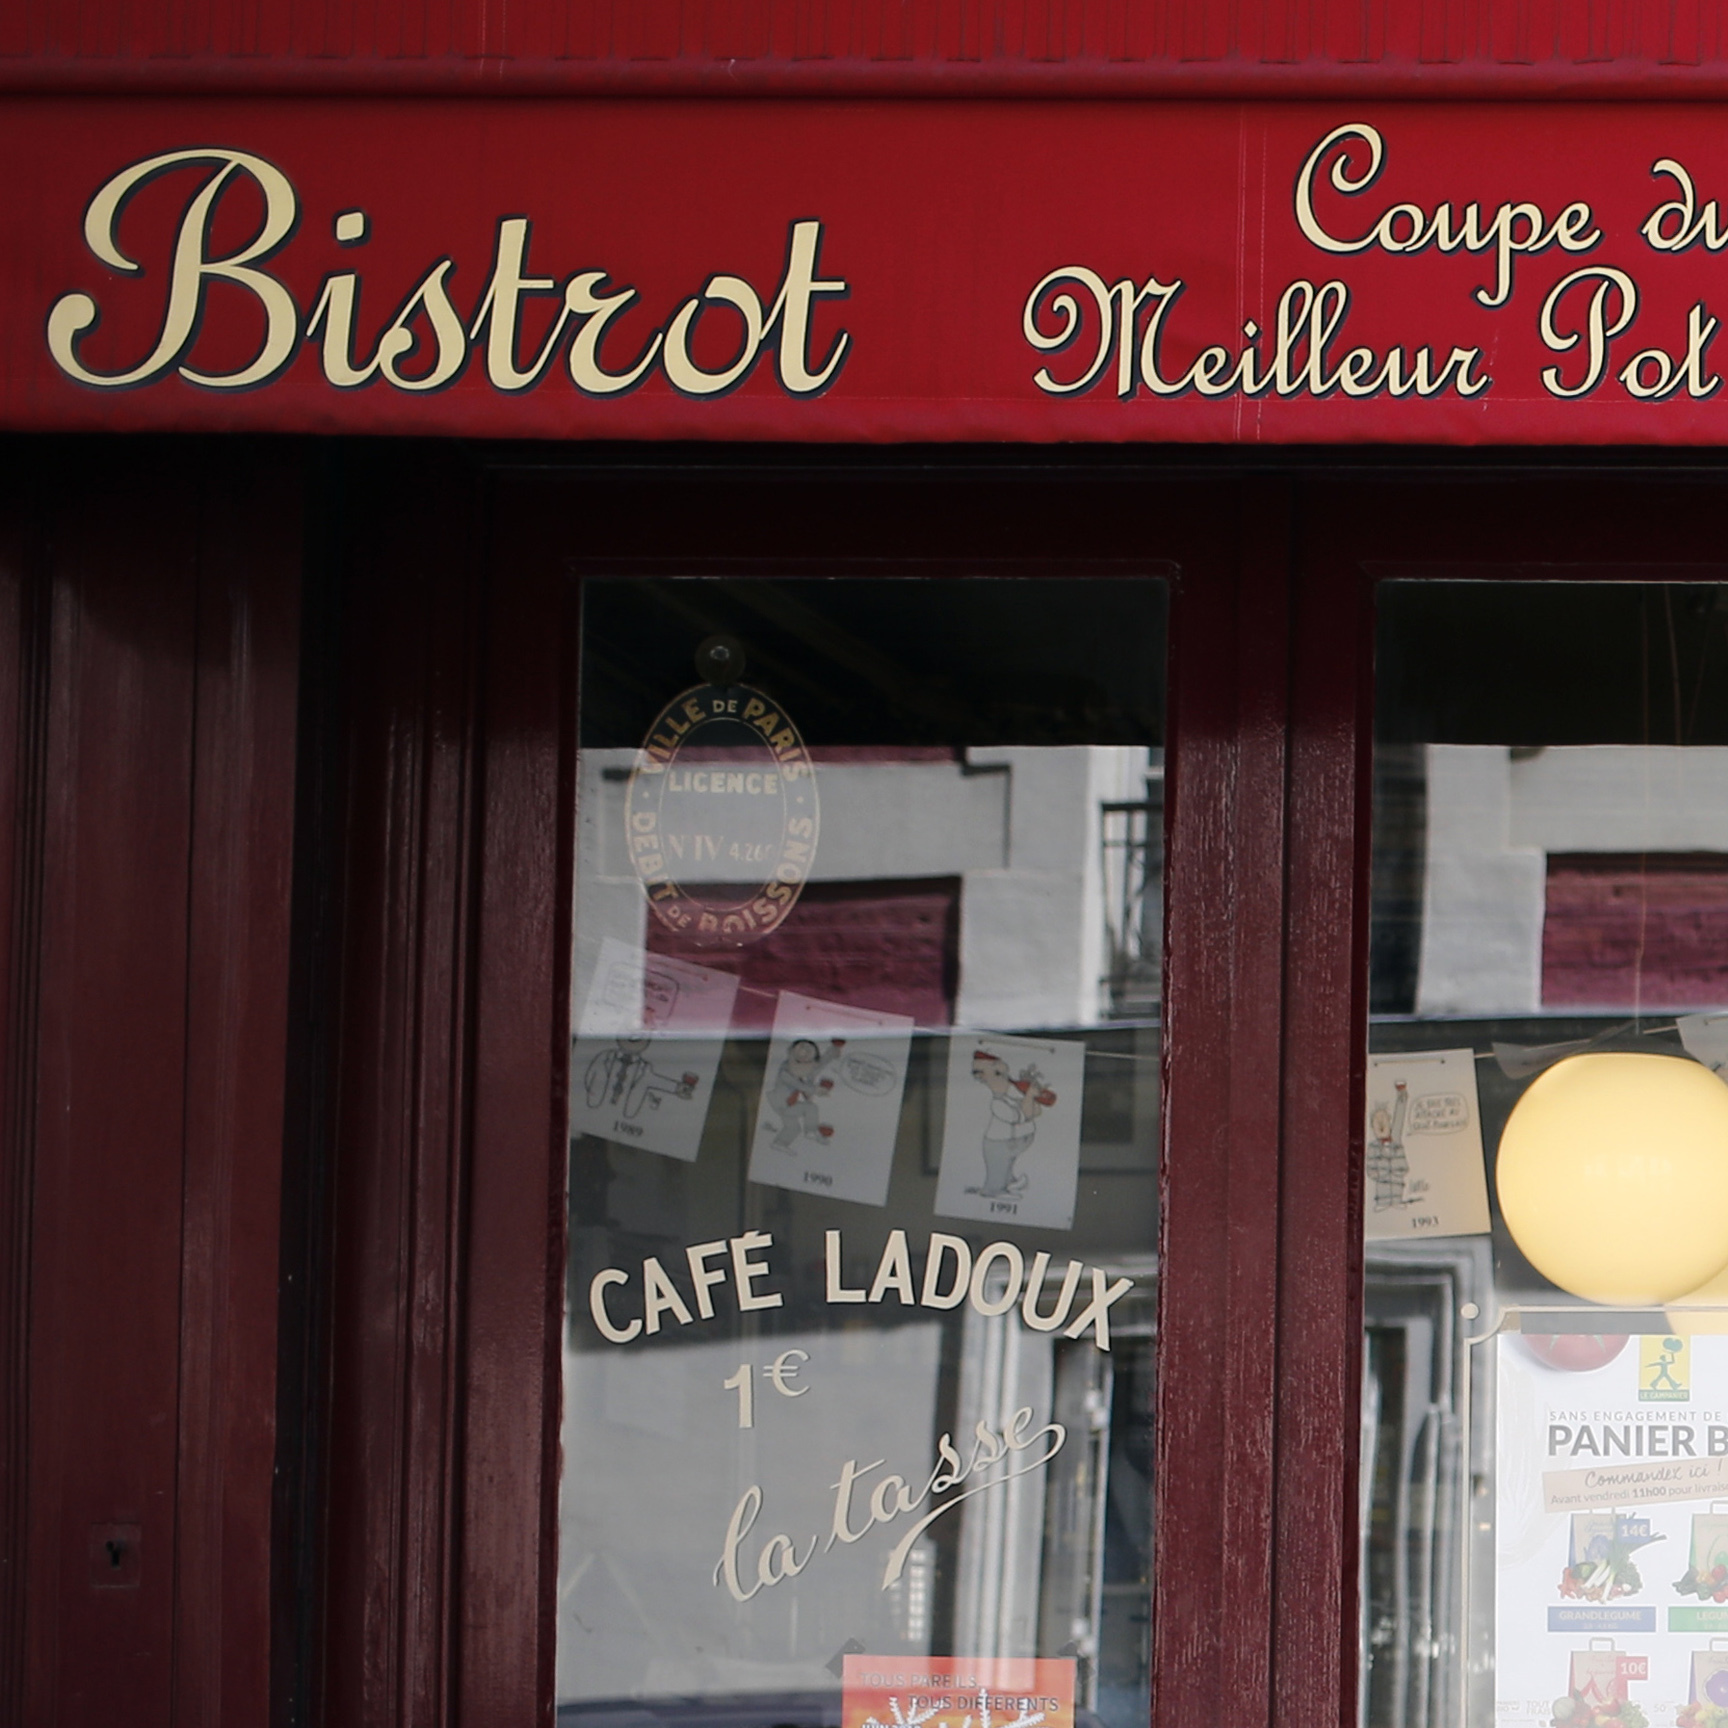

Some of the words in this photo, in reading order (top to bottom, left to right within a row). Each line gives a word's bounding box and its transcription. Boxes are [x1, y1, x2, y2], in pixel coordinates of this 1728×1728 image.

[1295, 124, 1601, 307] Coupe
[46, 147, 849, 395] Bistrot
[1022, 265, 1489, 398] Meilleur
[1540, 265, 1721, 400] Pot
[640, 698, 706, 776] VILLE
[712, 699, 738, 714] DE
[741, 698, 810, 782] PARIS
[668, 771, 779, 796] LICENCE
[632, 811, 680, 902] DEBIT
[698, 815, 814, 934] BOISSONS
[989, 1201, 1019, 1216] 1991
[1410, 1215, 1440, 1229] 1993
[589, 1230, 784, 1344] CAFÉ
[825, 1229, 1135, 1352] LADOUX
[722, 1348, 811, 1429] 1€
[1549, 1410, 1588, 1422] SANS
[1593, 1410, 1697, 1422] ENGAGEMENT
[1703, 1410, 1722, 1422] DE
[1548, 1424, 1697, 1457] PANIER
[712, 1484, 819, 1602] la
[825, 1406, 1067, 1560] tasse
